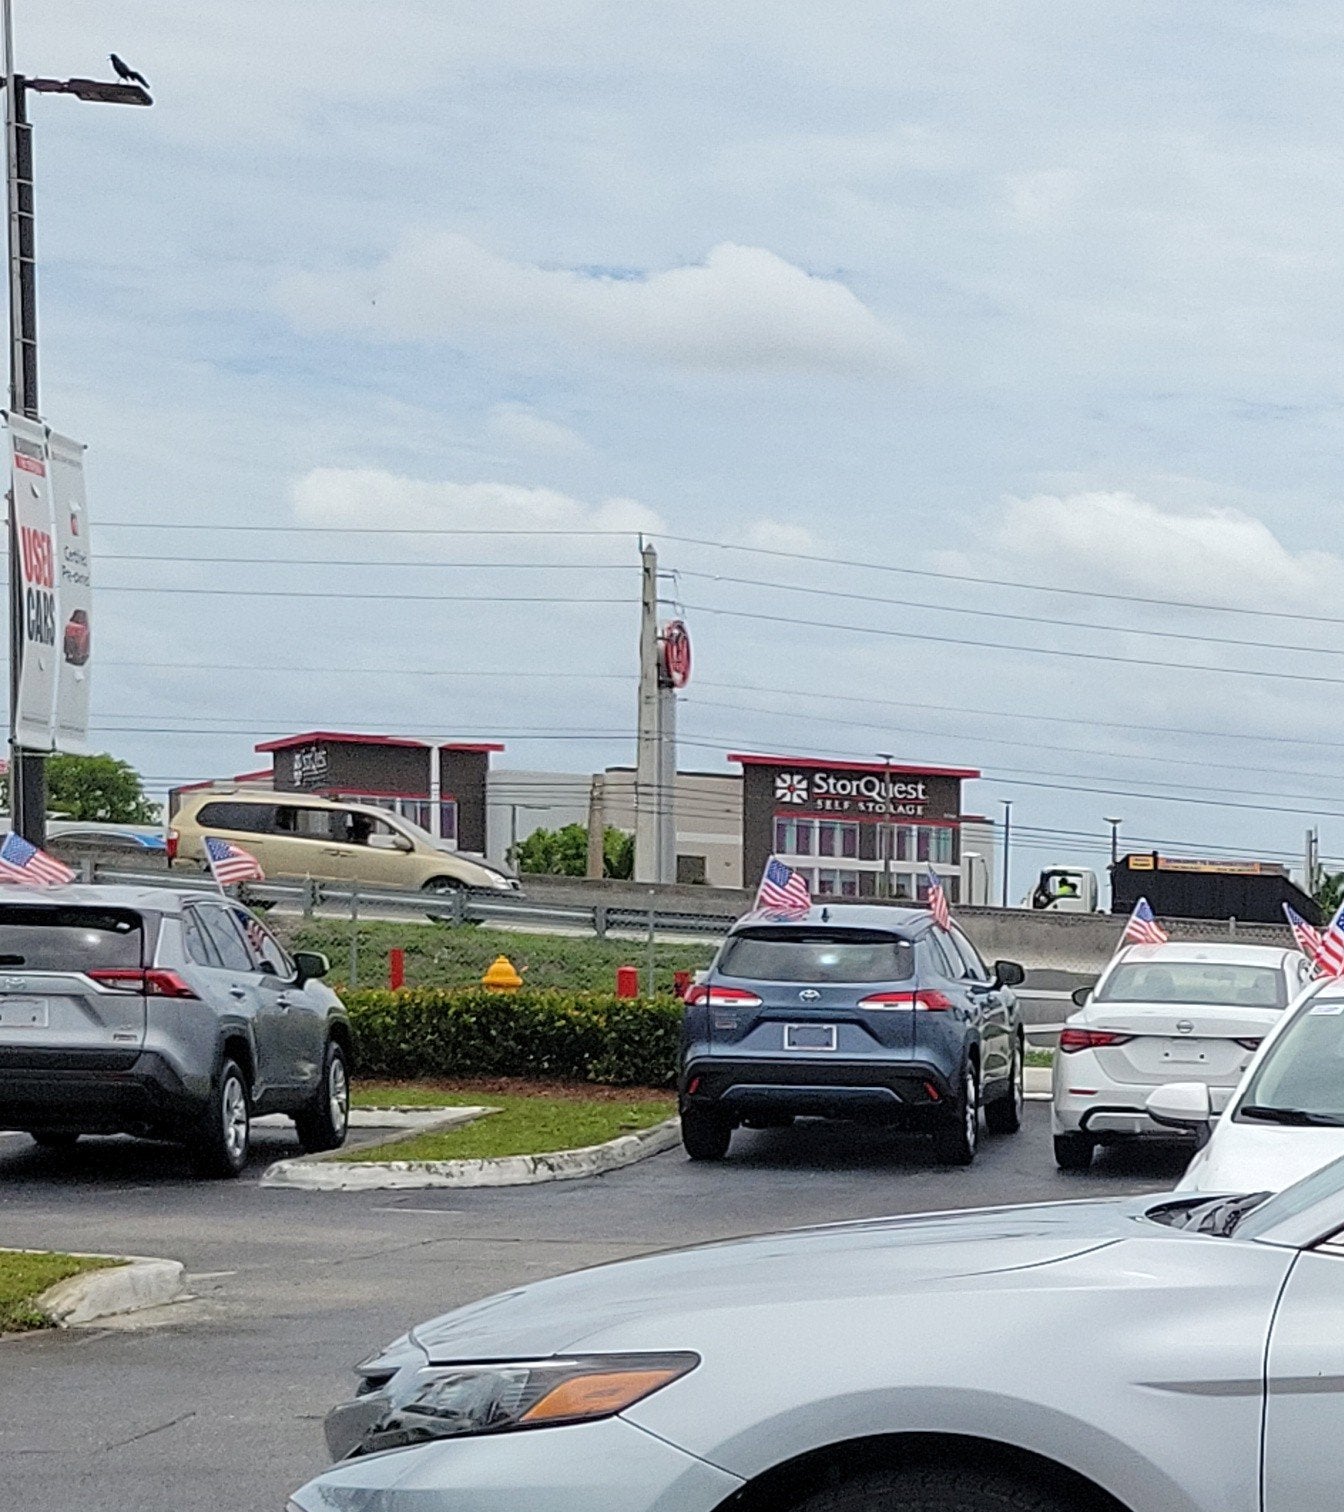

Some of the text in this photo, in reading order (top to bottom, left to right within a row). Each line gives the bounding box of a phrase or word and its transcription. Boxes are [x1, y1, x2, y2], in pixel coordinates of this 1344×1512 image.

[21, 525, 54, 588] USED
[27, 587, 55, 646] CARS
[813, 773, 927, 802] StorQuest
[816, 800, 851, 811] SELF
